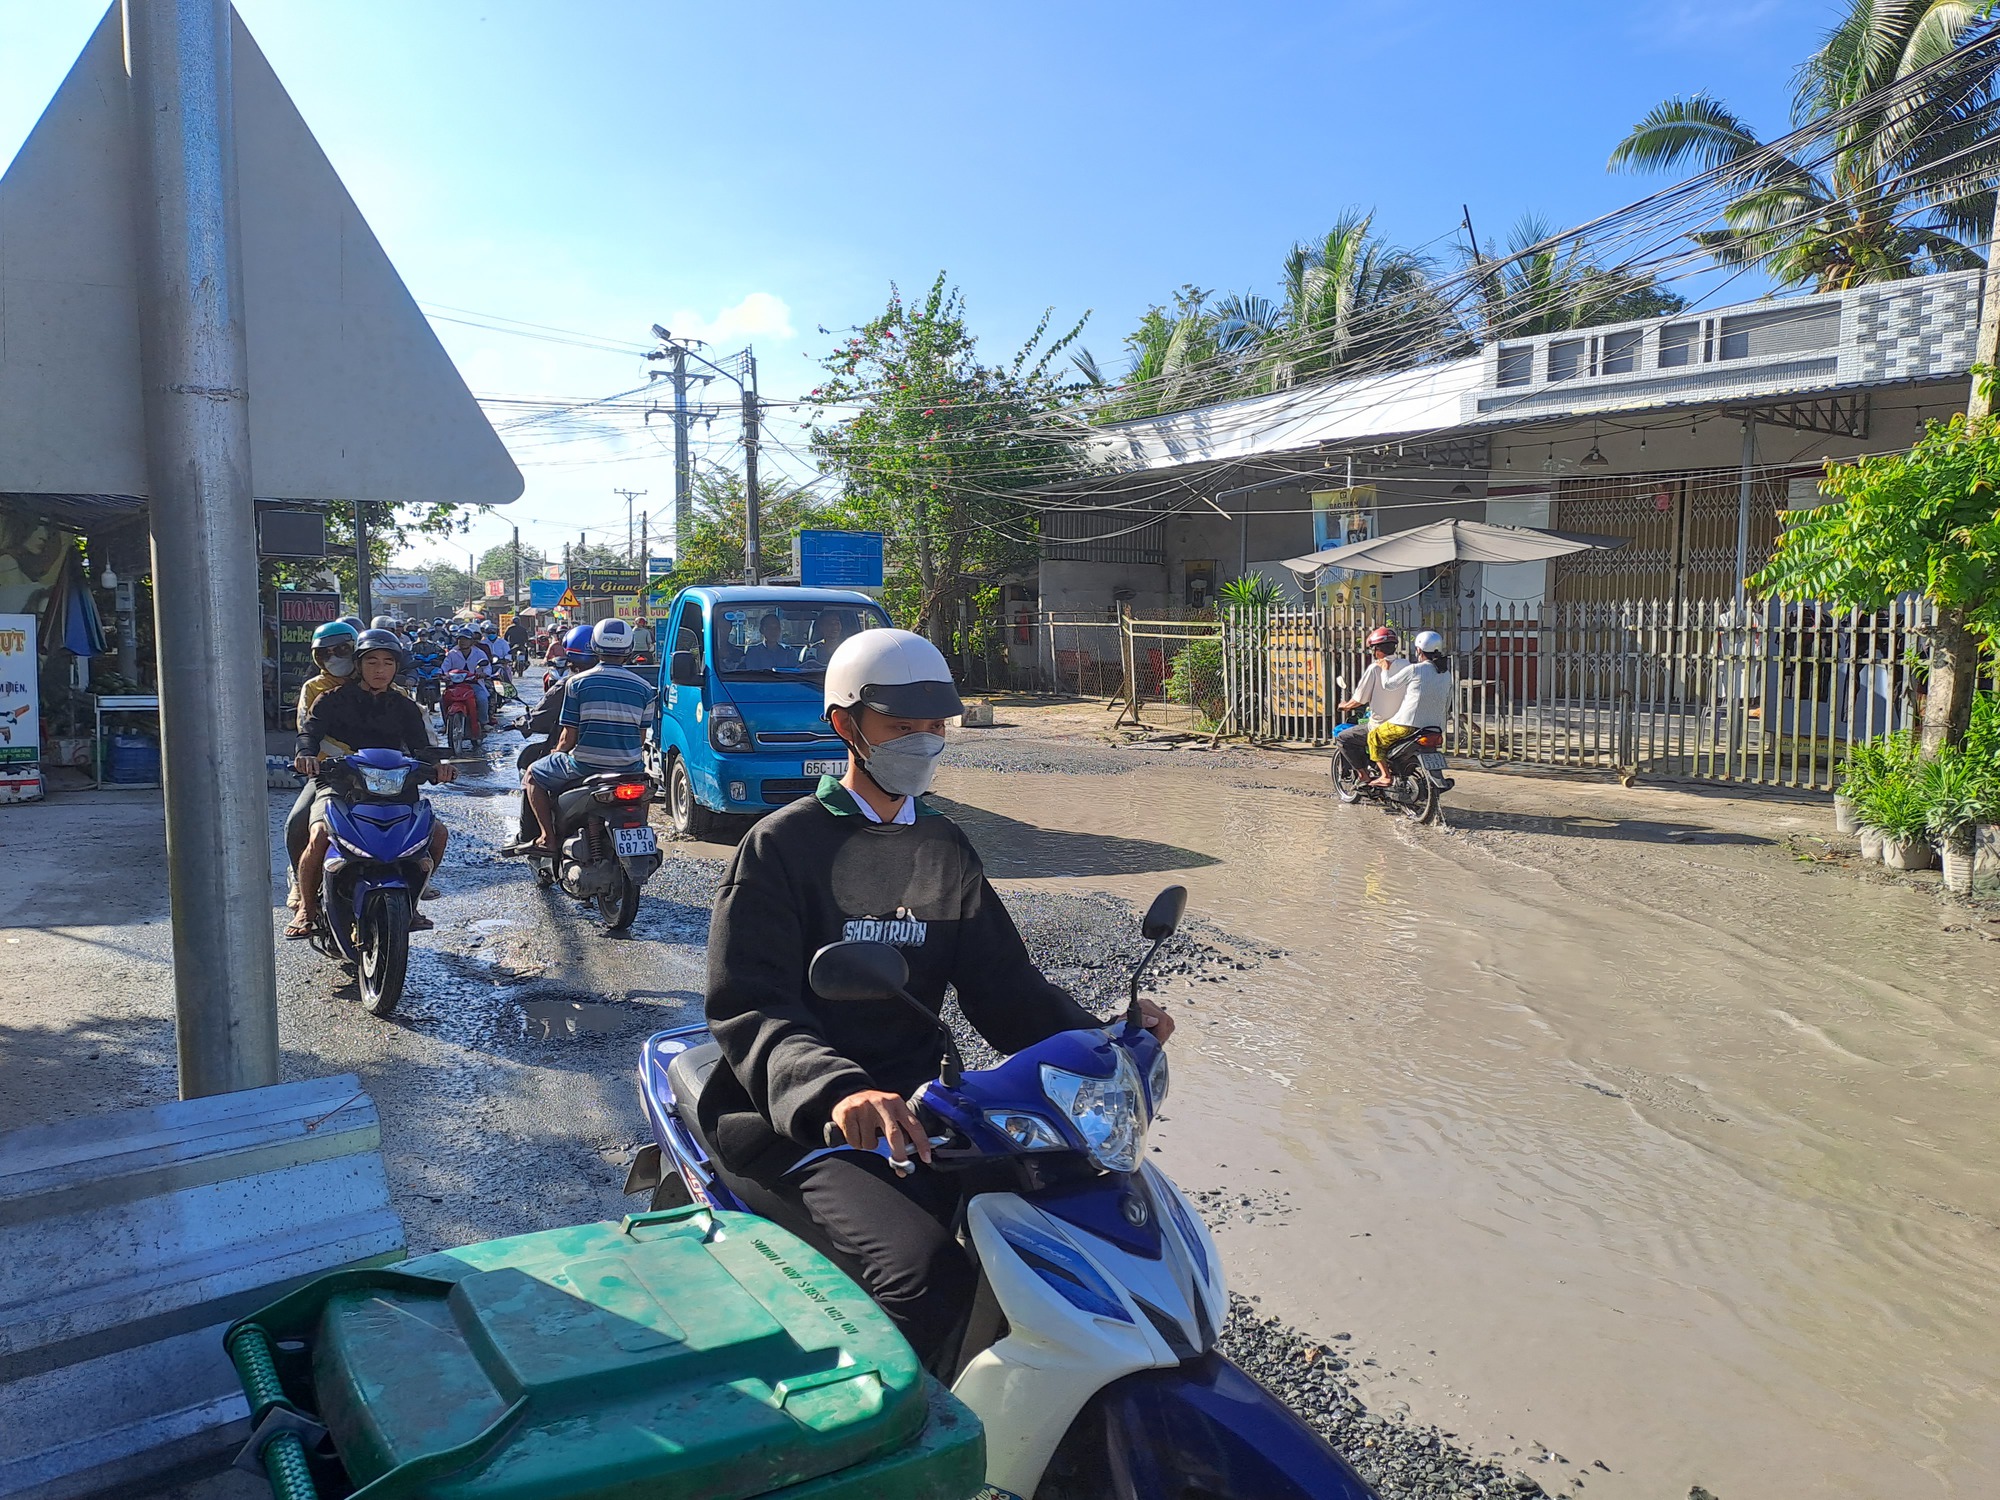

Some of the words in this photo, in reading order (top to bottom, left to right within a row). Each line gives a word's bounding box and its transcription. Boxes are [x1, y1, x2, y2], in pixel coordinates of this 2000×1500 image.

[572, 580, 595, 591] An
[281, 598, 336, 621] HOÀNG
[618, 841, 655, 855] 687.38
[781, 1266, 803, 1279] AND
[824, 1306, 846, 1321] HOT
[841, 1323, 859, 1335] NO
